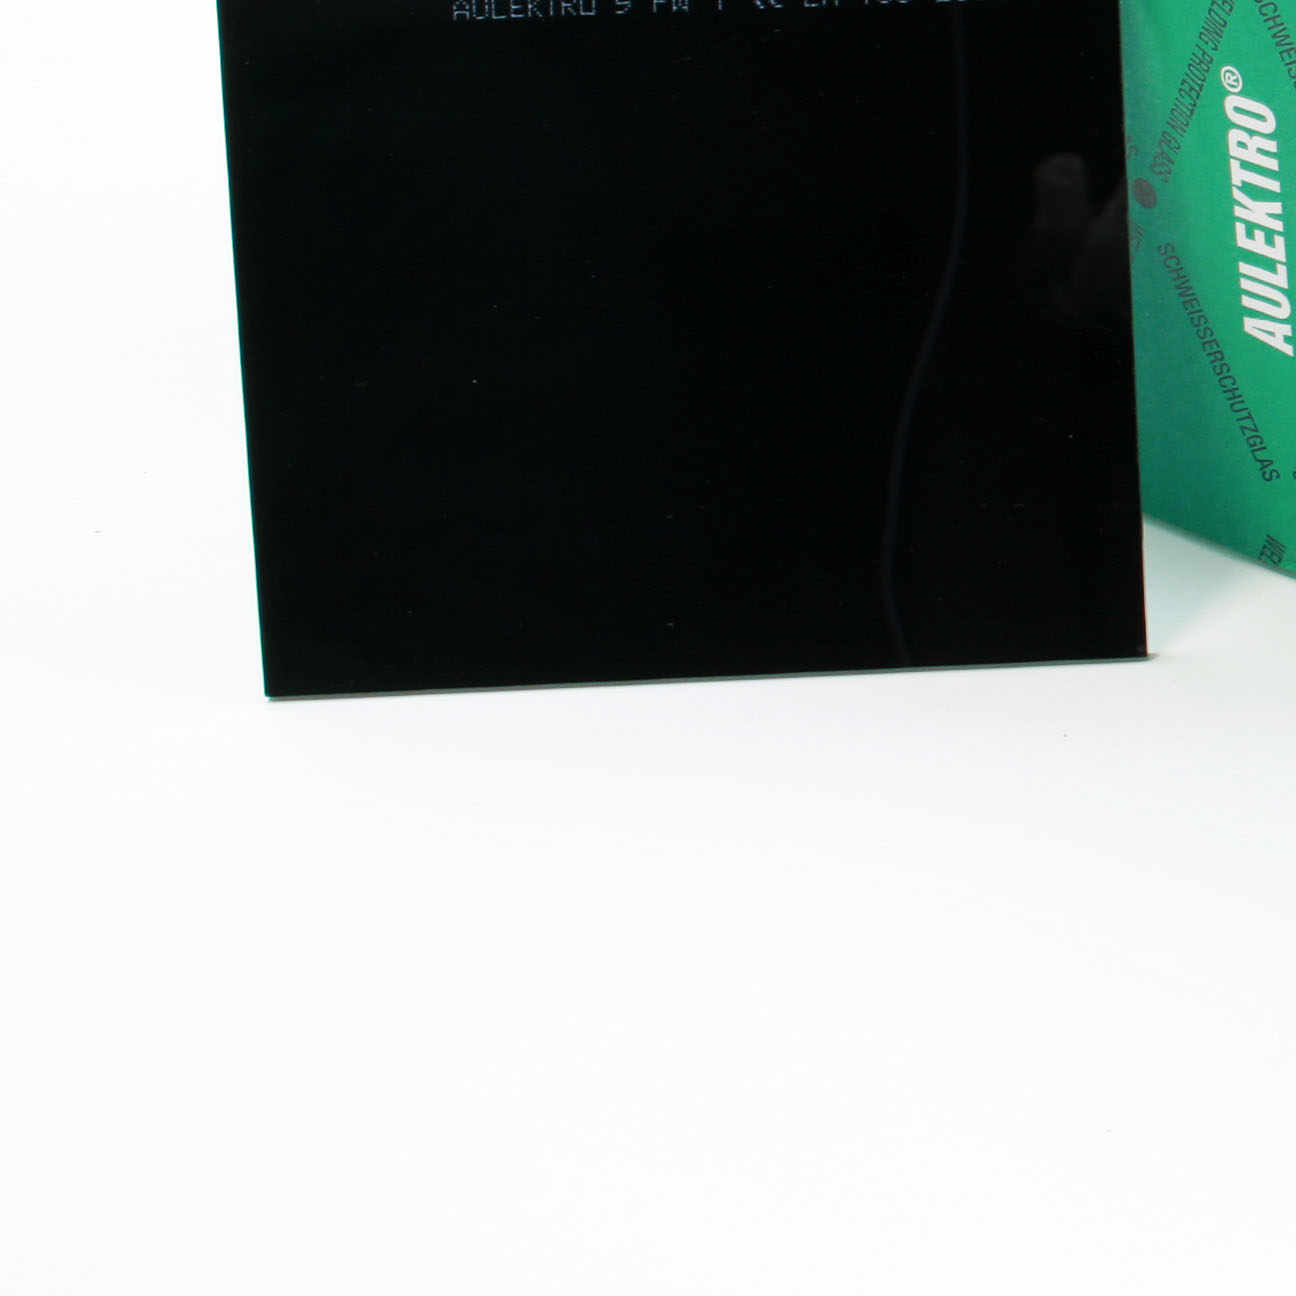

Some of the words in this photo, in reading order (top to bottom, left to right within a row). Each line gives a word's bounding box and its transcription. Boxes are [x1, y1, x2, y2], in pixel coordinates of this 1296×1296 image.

[1166, 44, 1213, 132] PROTECTION
[1150, 131, 1180, 182] GLASS
[1157, 243, 1281, 482] SCHWEISSERSCHUTZGLAS
